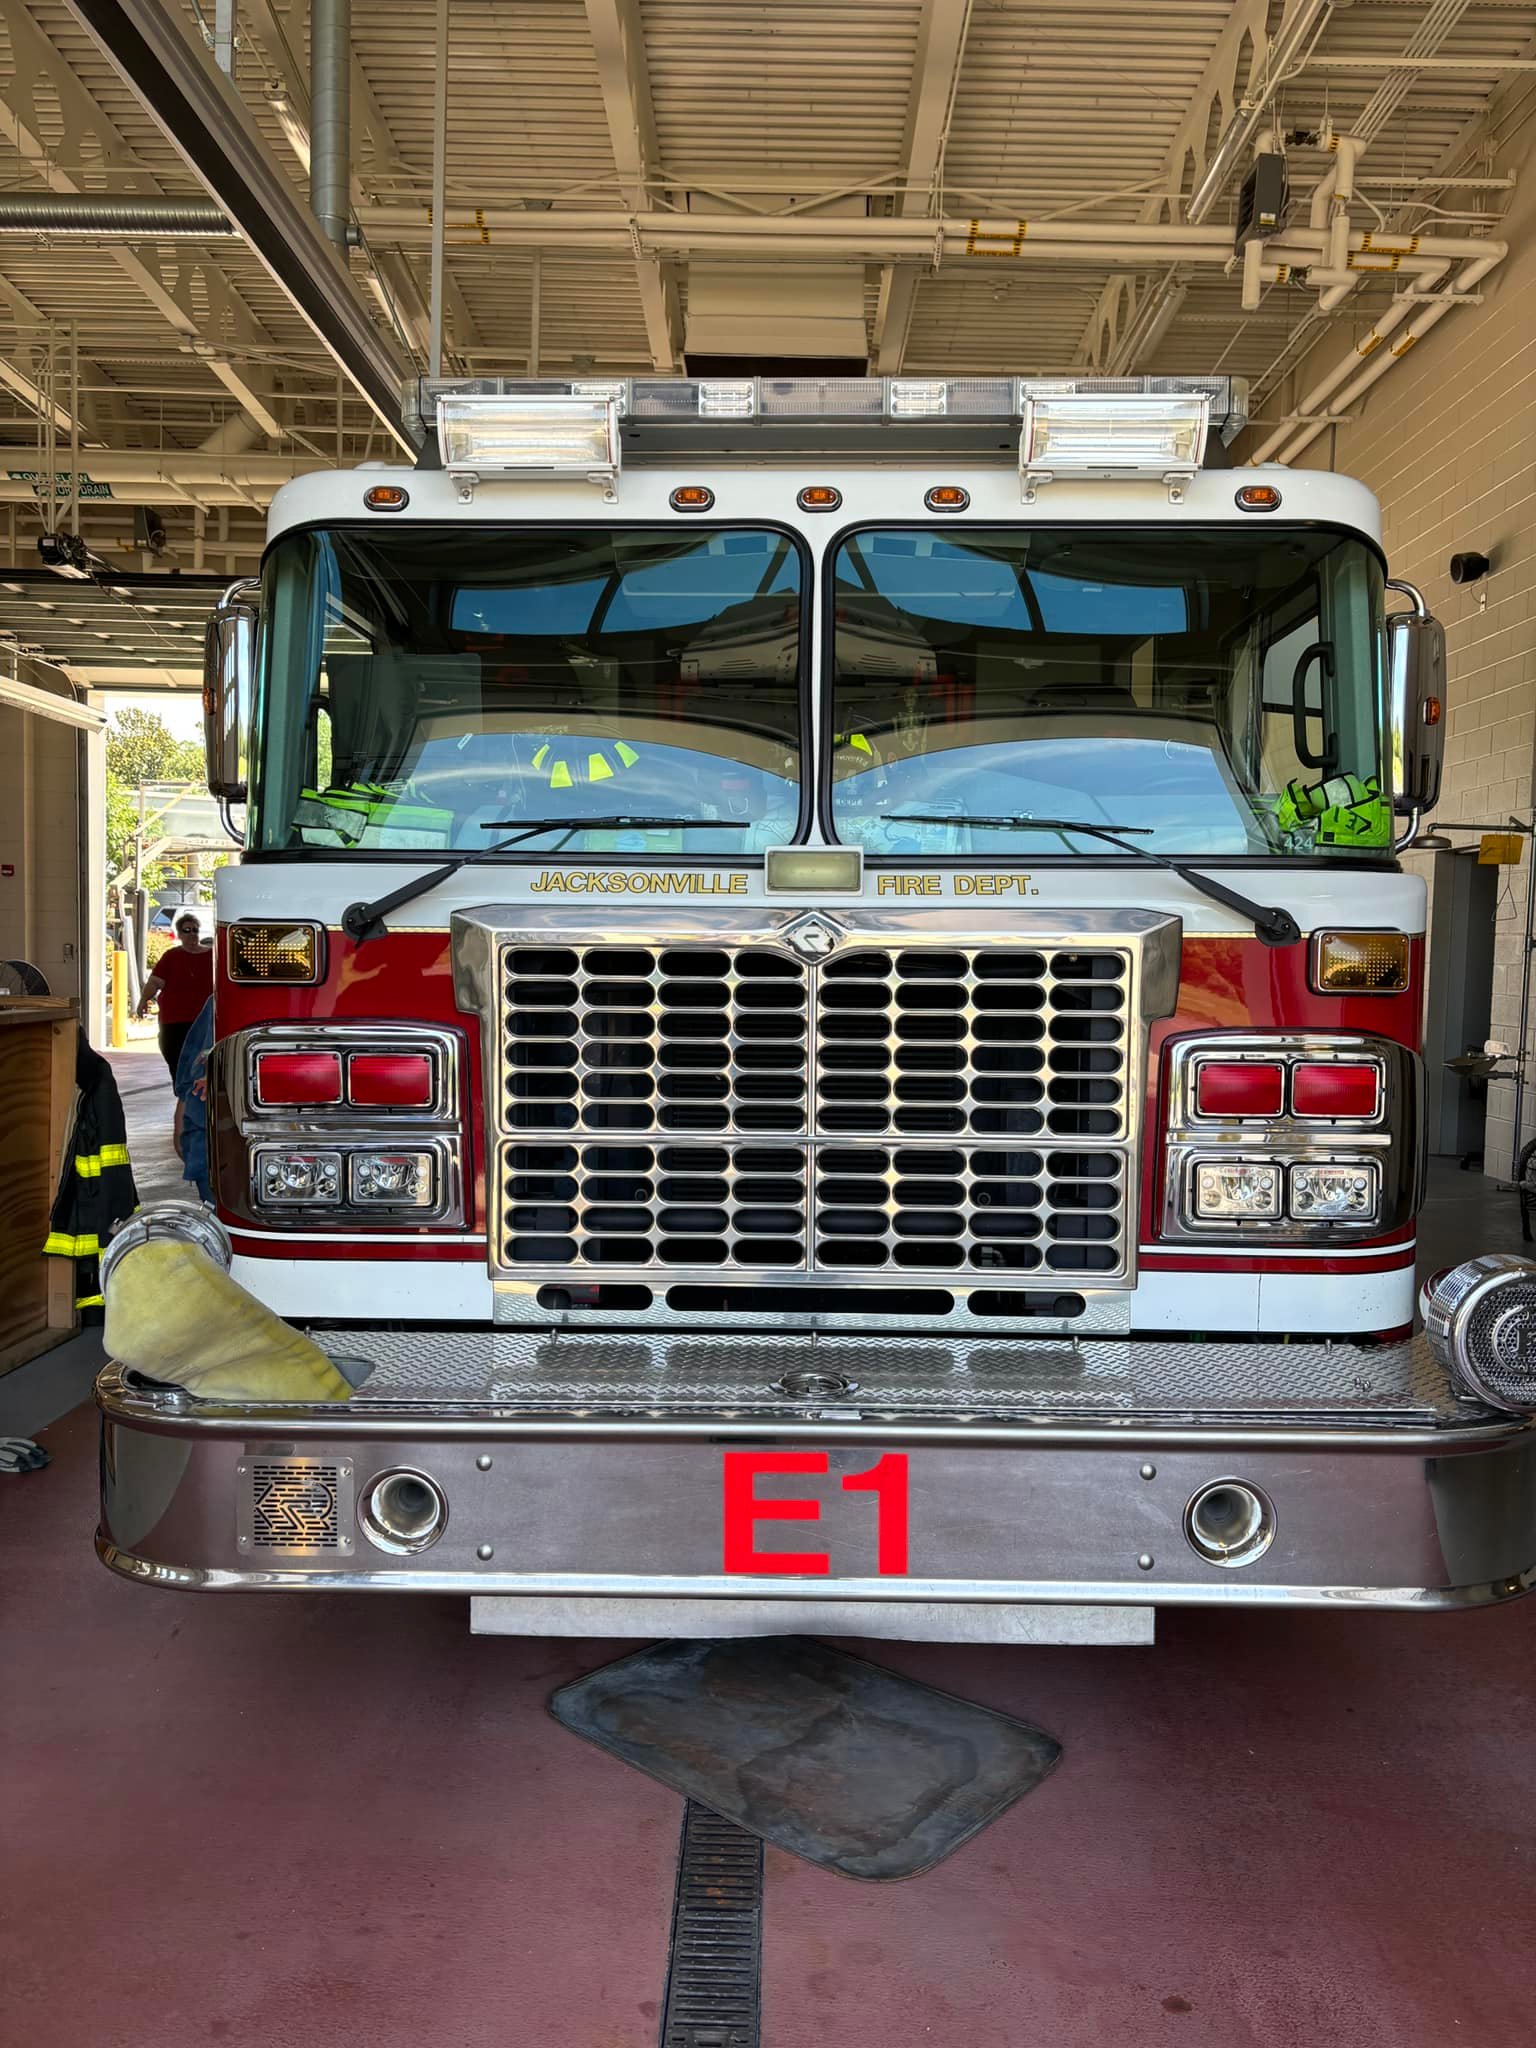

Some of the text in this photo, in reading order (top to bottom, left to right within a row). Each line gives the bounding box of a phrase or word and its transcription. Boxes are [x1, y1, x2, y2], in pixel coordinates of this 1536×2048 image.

[80, 484, 110, 495] DRAIN
[1284, 836, 1314, 850] 424
[530, 871, 1040, 896] JACKSONVILLE FIRE DEPT.
[723, 1452, 909, 1576] E1
